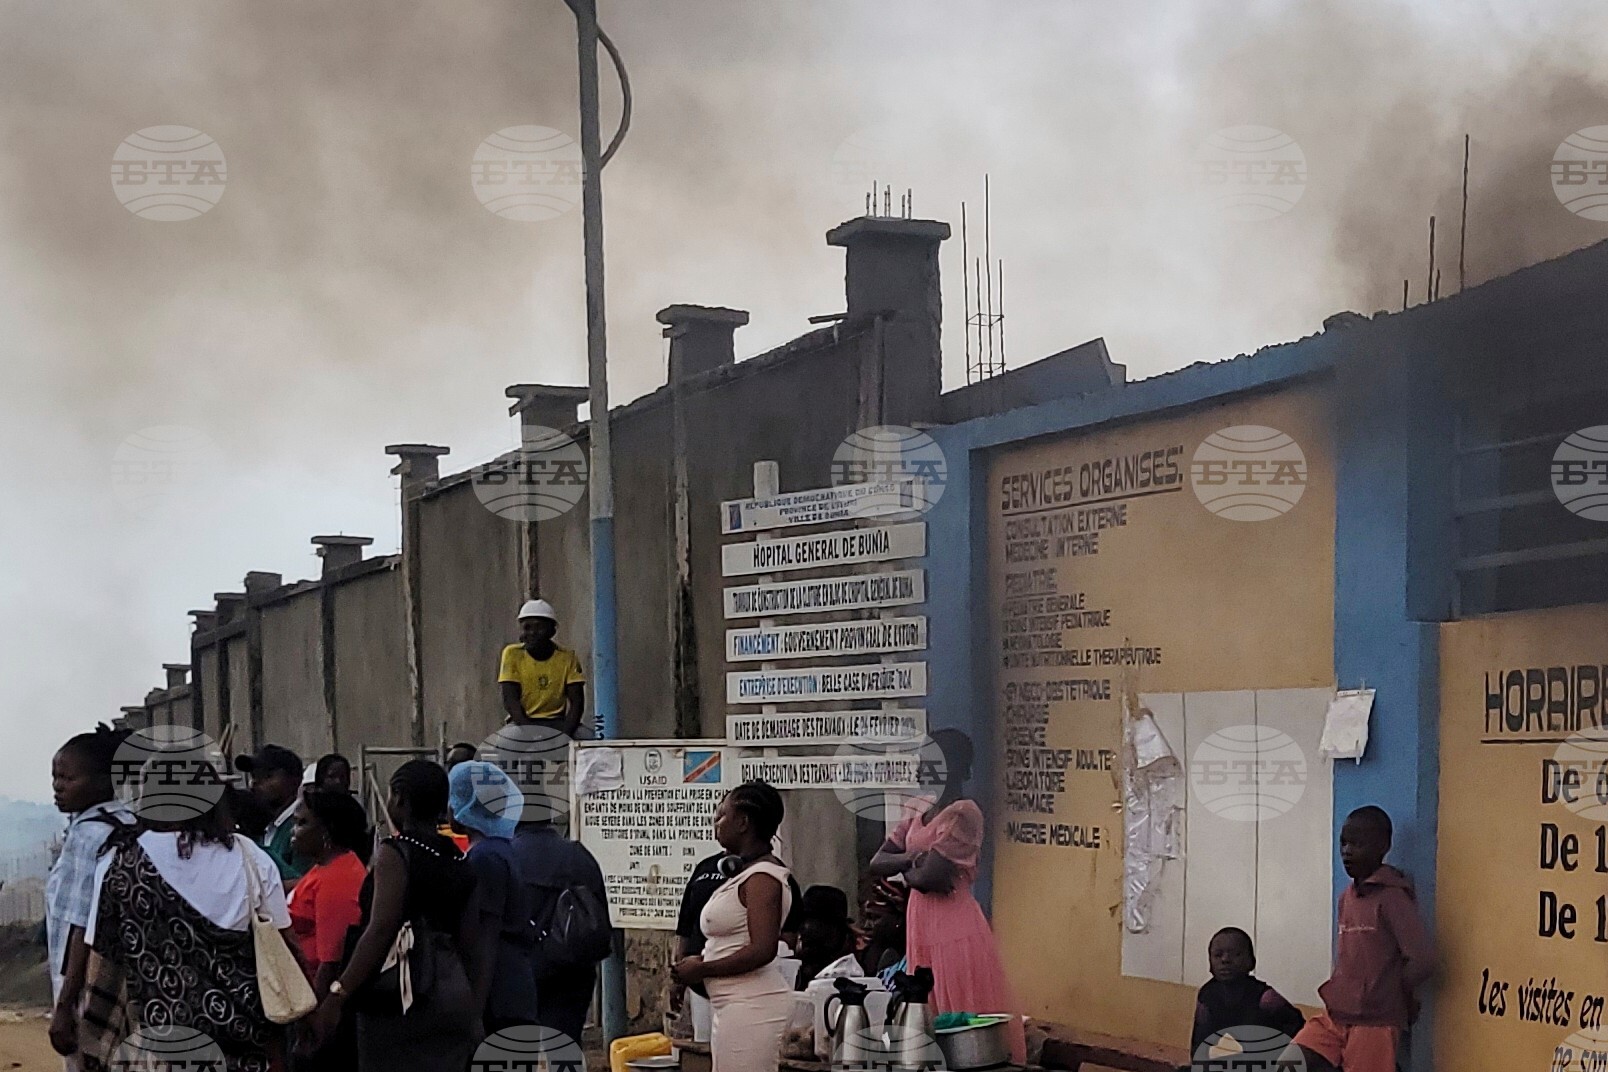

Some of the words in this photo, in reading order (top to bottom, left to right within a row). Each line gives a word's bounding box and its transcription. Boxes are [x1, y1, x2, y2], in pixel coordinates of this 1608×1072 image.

[1001, 466, 1073, 510] SERVICES
[1078, 504, 1127, 532] EXTERNE
[753, 544, 793, 568] HOPITAL
[795, 538, 839, 563] GENERAL
[842, 536, 857, 558] DE
[858, 531, 890, 556] BUNIA
[1056, 532, 1099, 557] INTERNE
[882, 625, 892, 647] DE
[1093, 647, 1161, 667] THERAPEUTIQUE
[735, 721, 750, 740] DATE
[751, 721, 760, 740] DE
[1076, 749, 1111, 770] ADULTE
[640, 775, 668, 785] USAID
[1541, 759, 1582, 804] De
[1050, 823, 1101, 849] MEDICALE
[1540, 823, 1579, 871] De
[1538, 891, 1577, 940] De
[1478, 967, 1508, 1018] Les
[1517, 976, 1574, 1027] visites
[1579, 989, 1604, 1029] en
